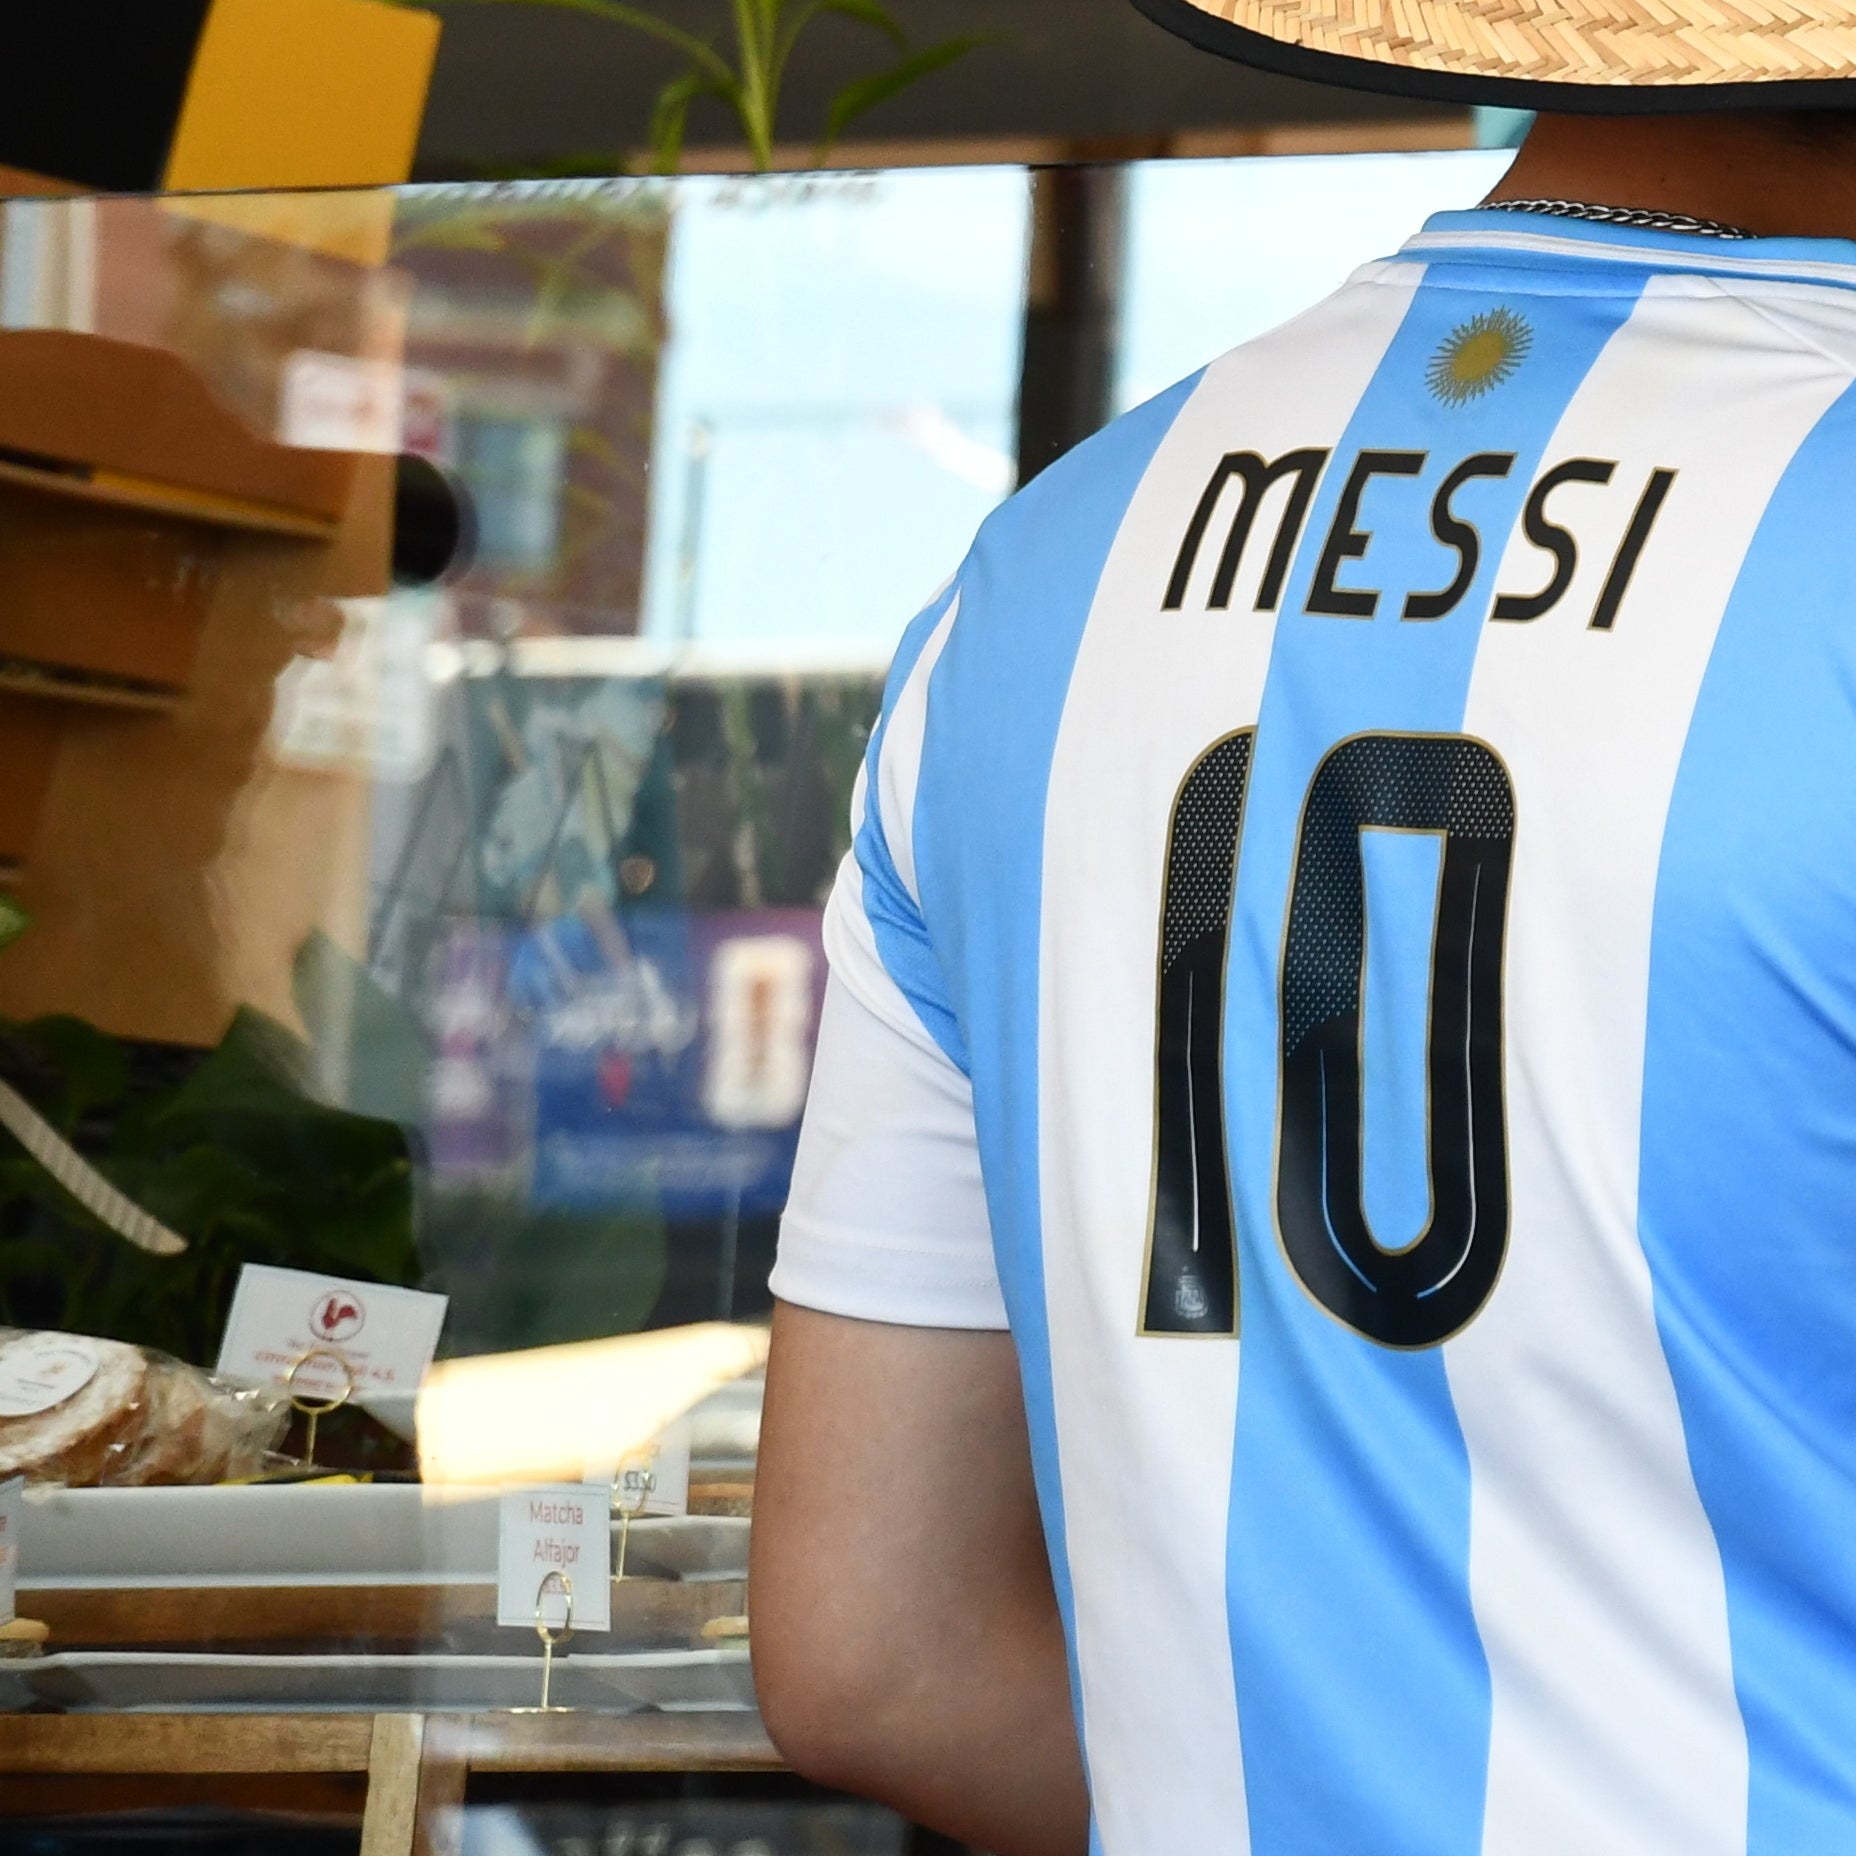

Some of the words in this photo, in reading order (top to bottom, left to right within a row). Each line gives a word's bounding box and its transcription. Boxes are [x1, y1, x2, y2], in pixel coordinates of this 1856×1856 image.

[1160, 447, 1680, 632] MESSI
[1136, 724, 1517, 1350] 10
[529, 1500, 584, 1525] Matcha
[532, 1538, 581, 1568] Alfajor
